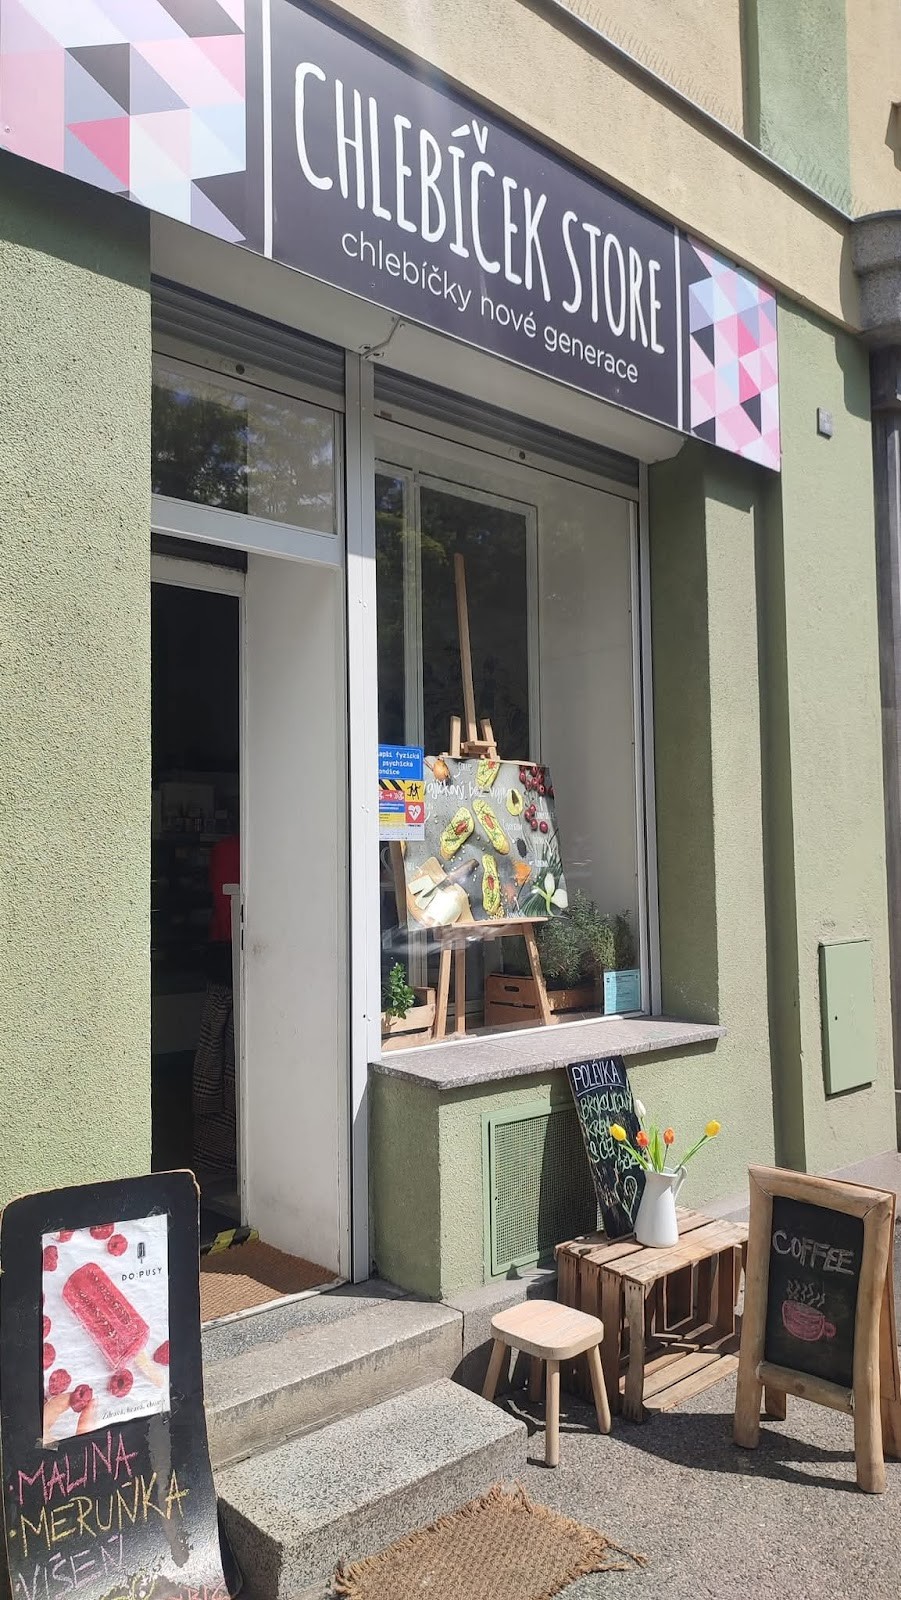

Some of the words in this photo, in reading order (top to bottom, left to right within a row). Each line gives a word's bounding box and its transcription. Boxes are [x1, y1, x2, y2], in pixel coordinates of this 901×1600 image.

[295, 62, 551, 302] CHLEBÍČEK
[562, 210, 665, 354] STORE
[341, 230, 472, 313] chlebíčky
[480, 294, 537, 339] nové
[543, 324, 639, 384] generace
[572, 1058, 622, 1092] POLÉVKA
[772, 1229, 855, 1276] COFFEE
